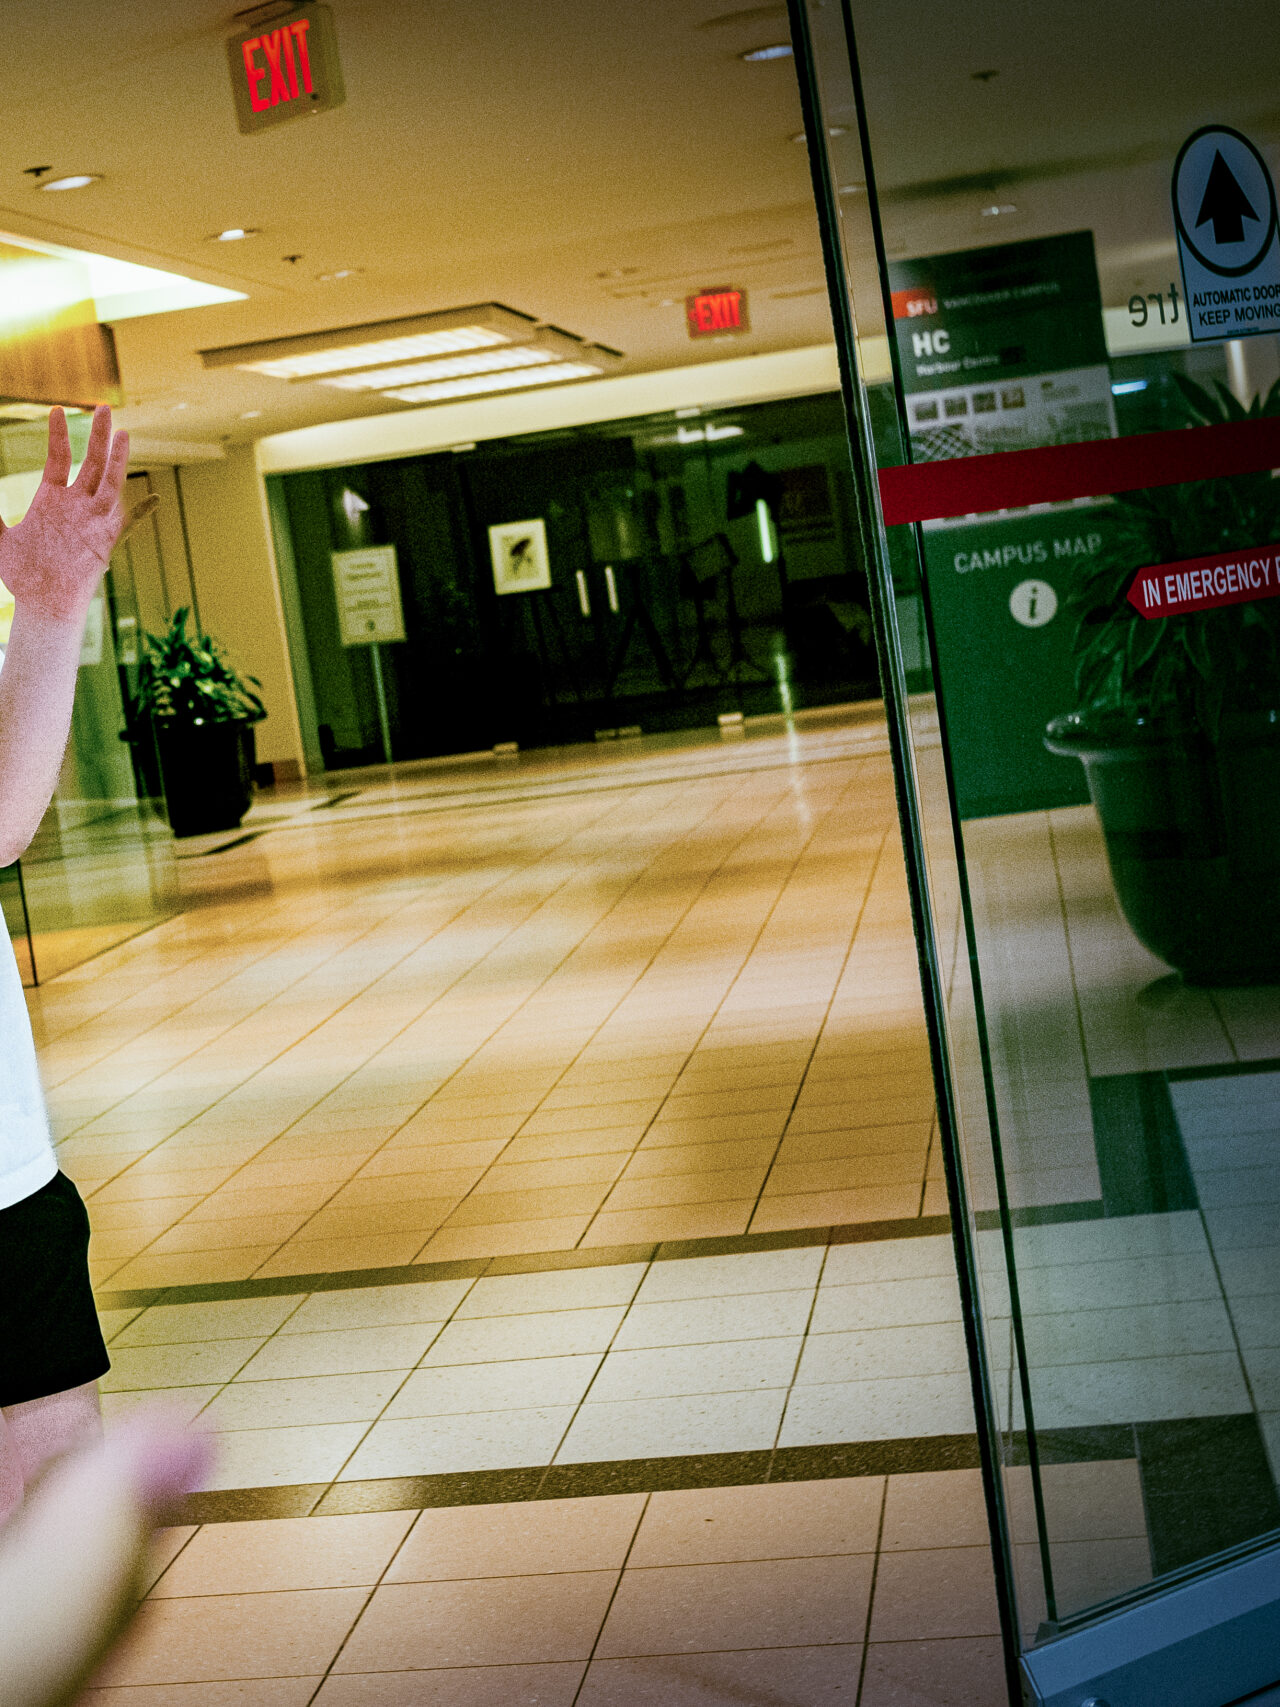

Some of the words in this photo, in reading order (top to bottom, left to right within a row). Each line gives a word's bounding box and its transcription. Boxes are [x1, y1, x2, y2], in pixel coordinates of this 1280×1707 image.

[241, 19, 313, 113] EXIT
[695, 292, 741, 332] EXIT
[906, 298, 939, 318] SFU
[1193, 287, 1251, 308] AUTOMATIC
[1198, 309, 1231, 327] KEEP
[1234, 303, 1280, 322] MOVING
[912, 329, 951, 358] HC
[954, 540, 1048, 574] CAMPUS
[1053, 533, 1102, 559] MAP
[1142, 577, 1161, 608] IN
[1164, 558, 1270, 604] EMERGENCY
